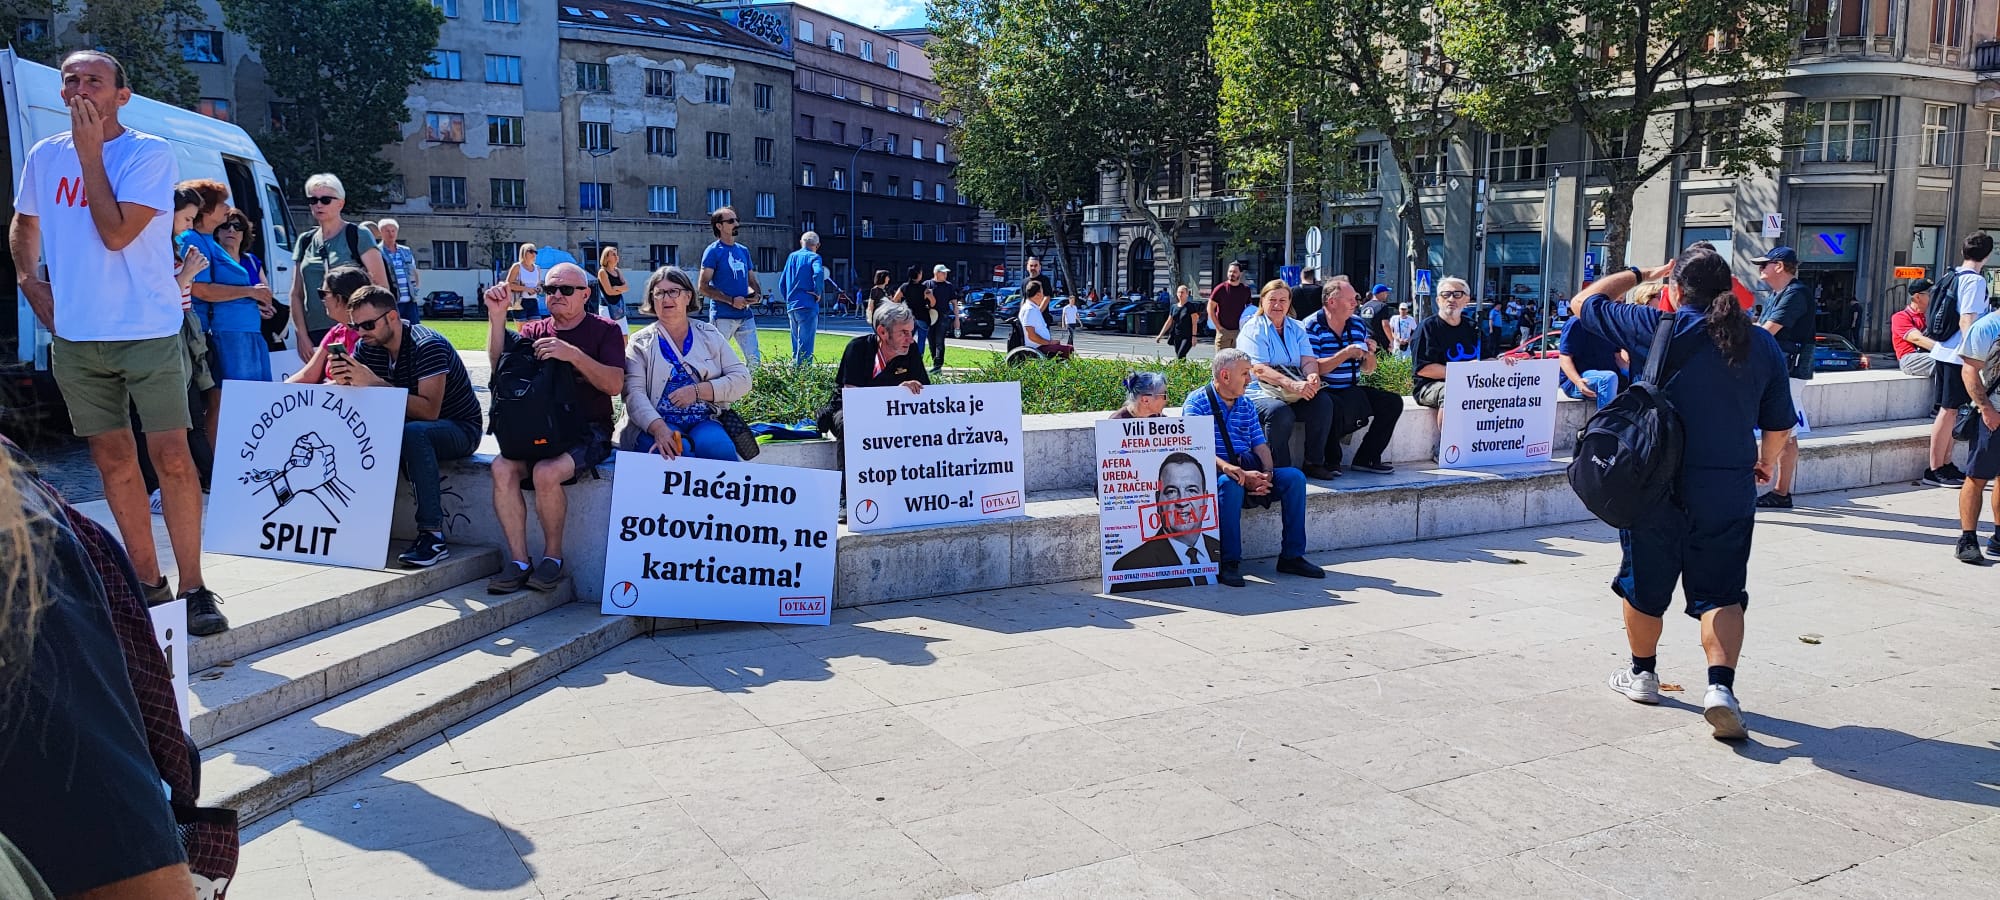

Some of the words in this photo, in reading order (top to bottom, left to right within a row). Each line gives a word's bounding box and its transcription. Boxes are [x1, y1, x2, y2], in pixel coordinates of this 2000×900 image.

[1466, 373, 1506, 389] Visoke
[1507, 372, 1541, 389] cijene
[886, 396, 966, 416] Hrvatska
[969, 395, 984, 416] je
[1461, 398, 1527, 412] energenata
[1528, 396, 1542, 407] su
[240, 389, 314, 461] SLOBODNI
[321, 391, 376, 470] ZAJEDNO
[1122, 421, 1145, 436] Vili
[1148, 419, 1185, 435] Beroš
[1476, 416, 1524, 433] umjetno
[862, 433, 943, 450] suverena
[946, 426, 1008, 446] država,
[1121, 438, 1150, 448] AFERA
[1471, 435, 1525, 453] stvorene!
[858, 466, 897, 485] stop
[901, 458, 1014, 481] totalitarizmu
[1102, 458, 1131, 469] AFERA
[1102, 470, 1138, 481] UREĐAJ
[662, 471, 797, 507] Plaćajmo
[1103, 484, 1115, 494] ZA
[904, 490, 974, 513] WHO-a!
[985, 496, 1017, 508] OTKAZ
[1148, 504, 1210, 530] OTKAZ
[259, 521, 337, 556] SPLIT
[619, 513, 787, 552] gotovinom,
[794, 528, 828, 549] ne
[640, 553, 802, 588] karticama!
[784, 601, 822, 612] OTKAZ
